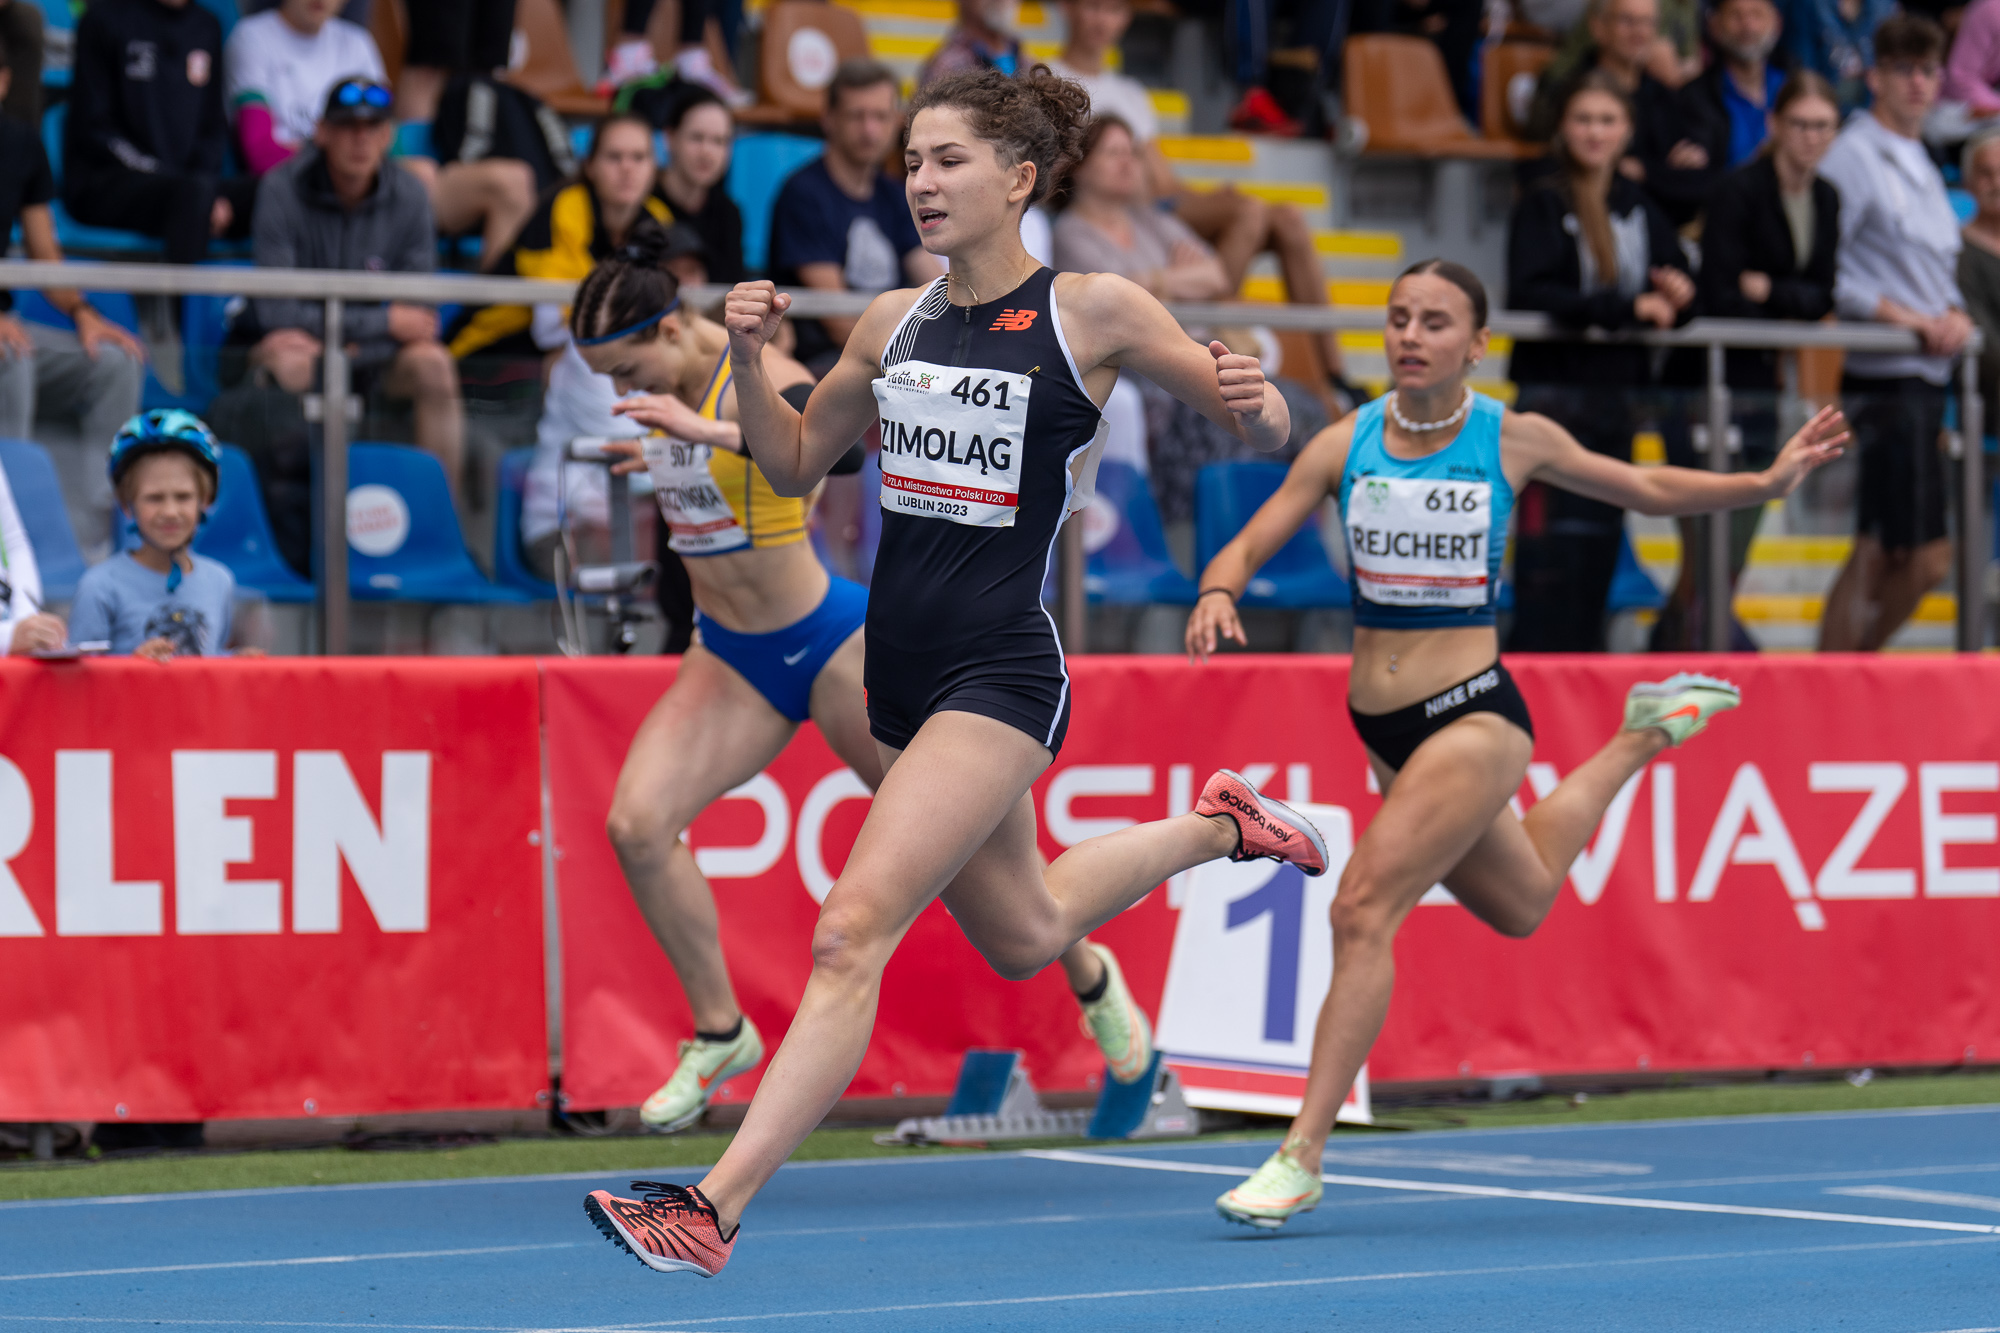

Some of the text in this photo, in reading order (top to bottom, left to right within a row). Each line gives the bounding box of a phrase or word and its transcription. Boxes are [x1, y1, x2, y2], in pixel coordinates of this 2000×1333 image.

[951, 376, 1010, 411] 461
[881, 417, 1012, 475] ZIMOLĄG
[887, 476, 903, 488] PZLA
[904, 480, 952, 496] Mistrzostwa
[955, 488, 983, 501] Polski
[985, 494, 1005, 504] U20
[897, 495, 968, 517] LUBLIN 2023
[1425, 488, 1477, 512] 616
[1353, 526, 1483, 560] REJCHERT
[1425, 684, 1467, 718] NIKE
[1219, 790, 1293, 843] new balance
[1225, 862, 1307, 1044] 1
